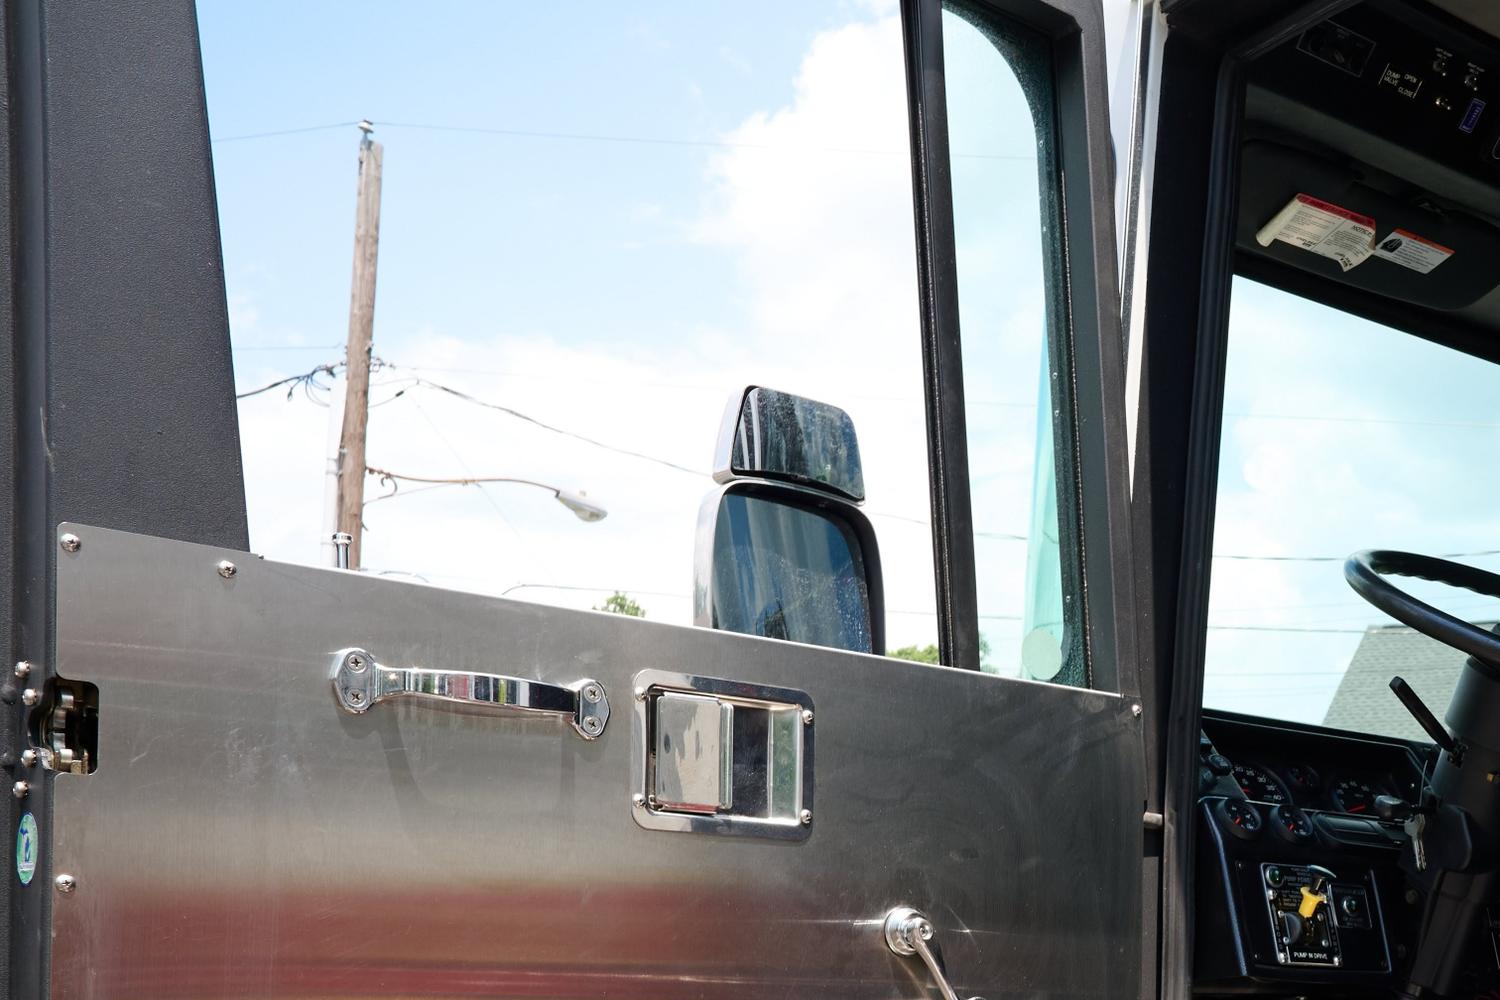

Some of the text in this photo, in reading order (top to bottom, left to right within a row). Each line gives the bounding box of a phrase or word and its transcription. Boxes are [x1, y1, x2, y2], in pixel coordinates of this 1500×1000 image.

[1386, 69, 1401, 79] DUMP
[1403, 73, 1418, 84] OPEN
[1397, 86, 1414, 98] CLOSE
